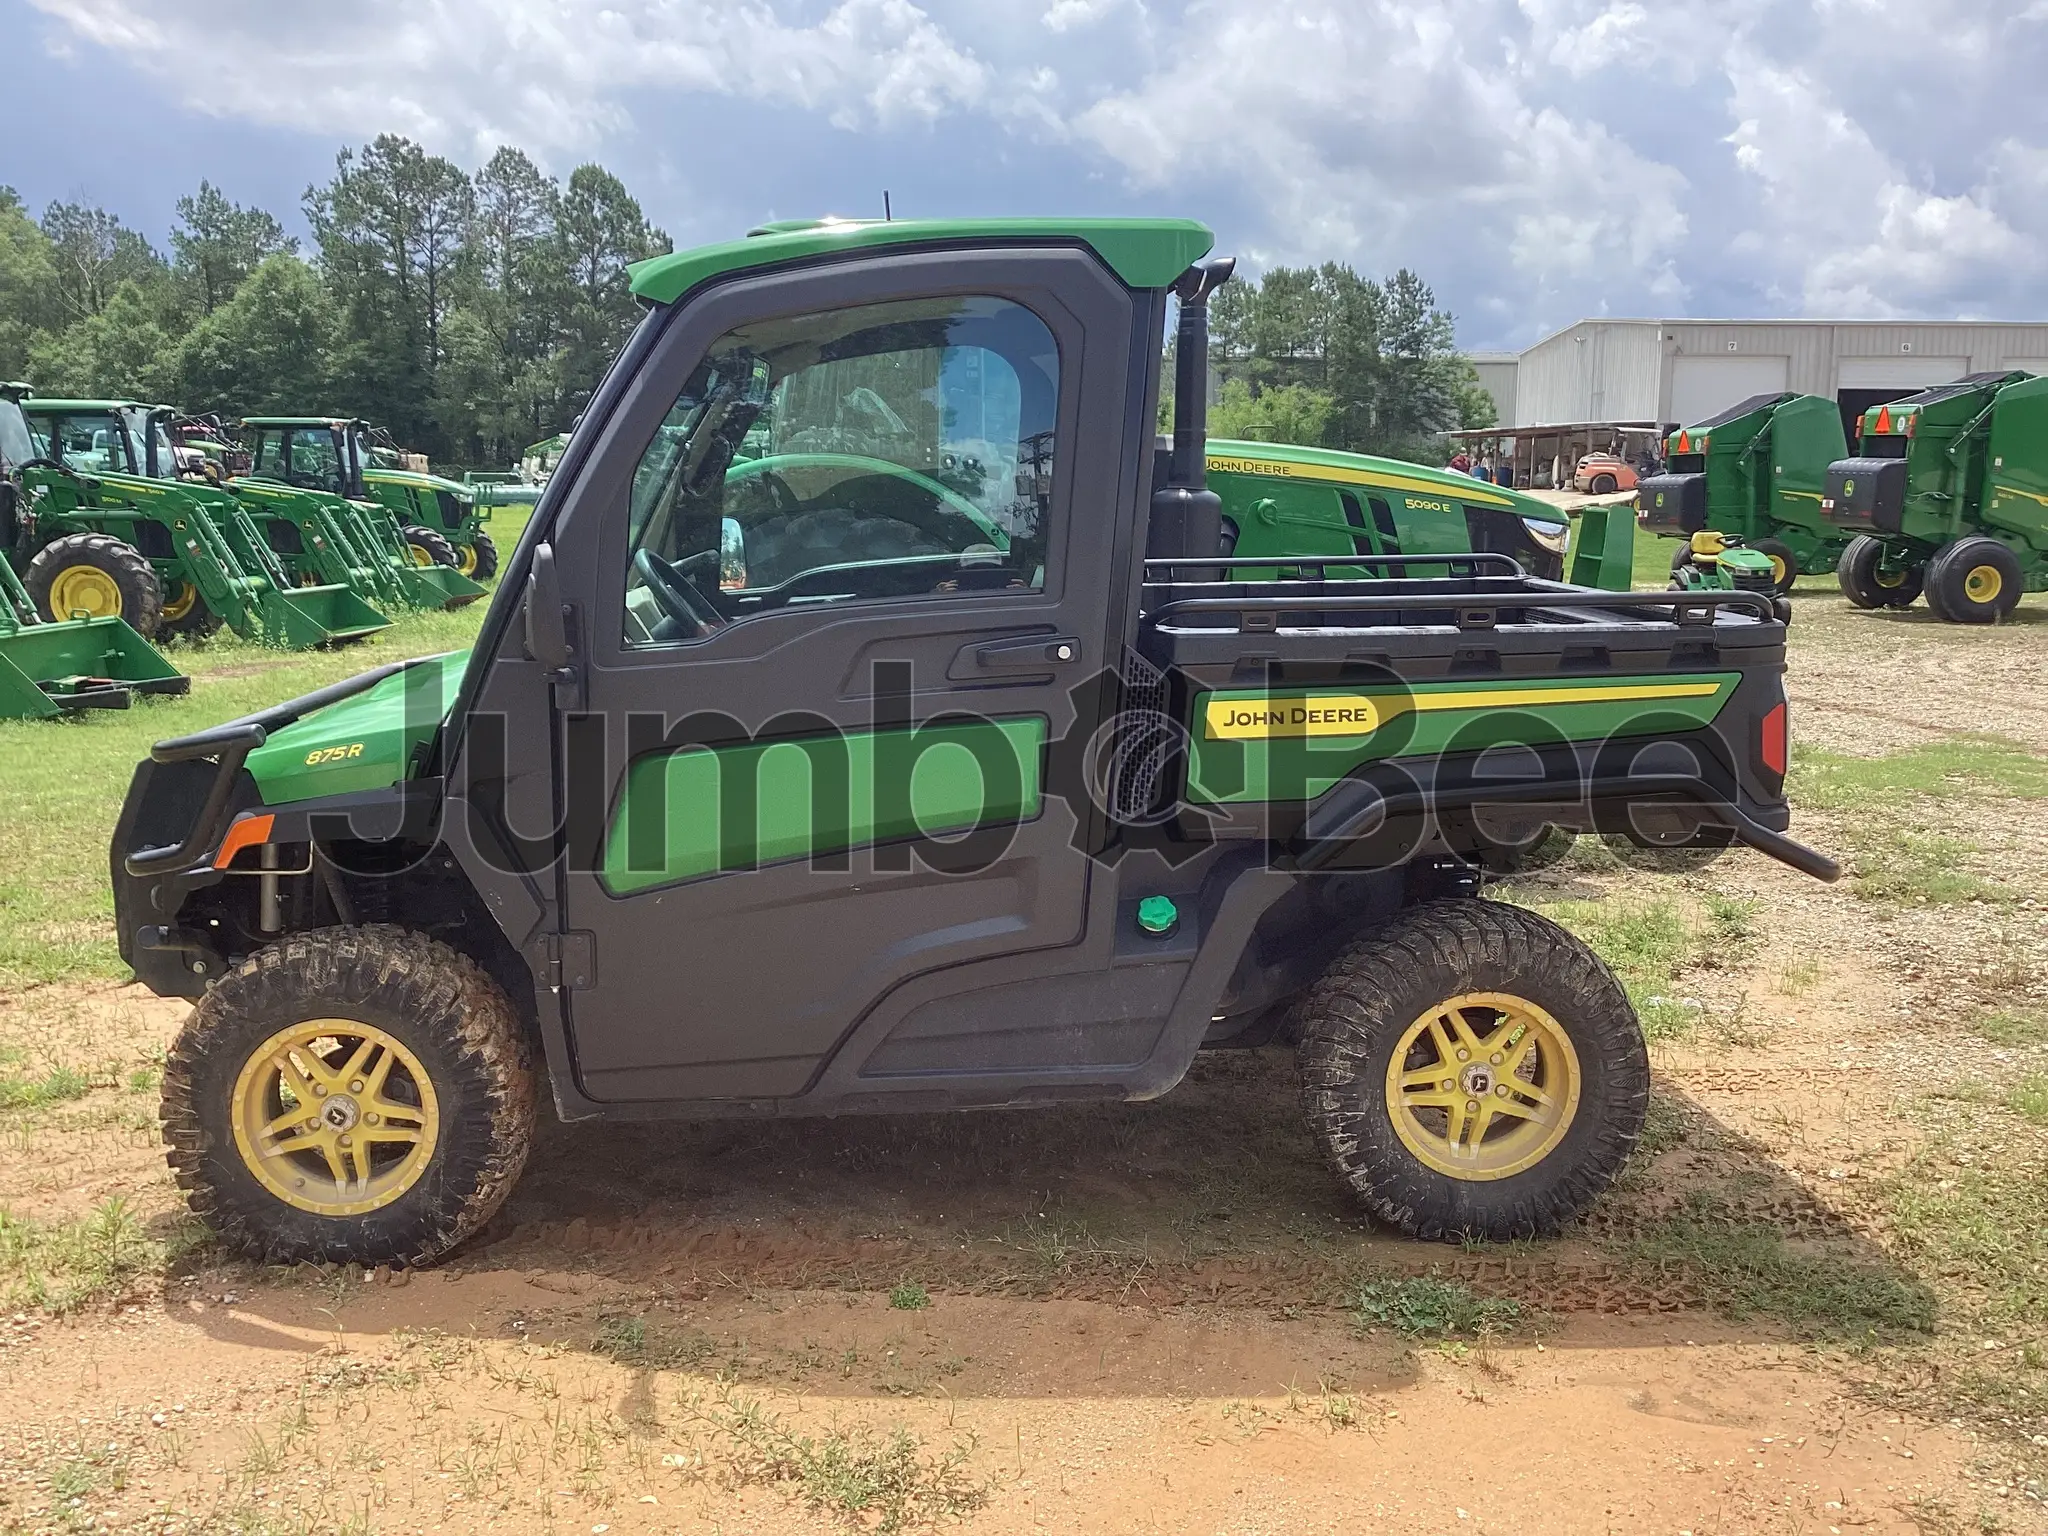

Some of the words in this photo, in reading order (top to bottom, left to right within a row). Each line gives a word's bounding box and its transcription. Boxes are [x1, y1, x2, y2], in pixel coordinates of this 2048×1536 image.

[1206, 459, 1241, 471] JOHN
[1243, 461, 1291, 475] DEERE
[1223, 710, 1285, 727] JOHN
[1291, 708, 1368, 724] DEERE
